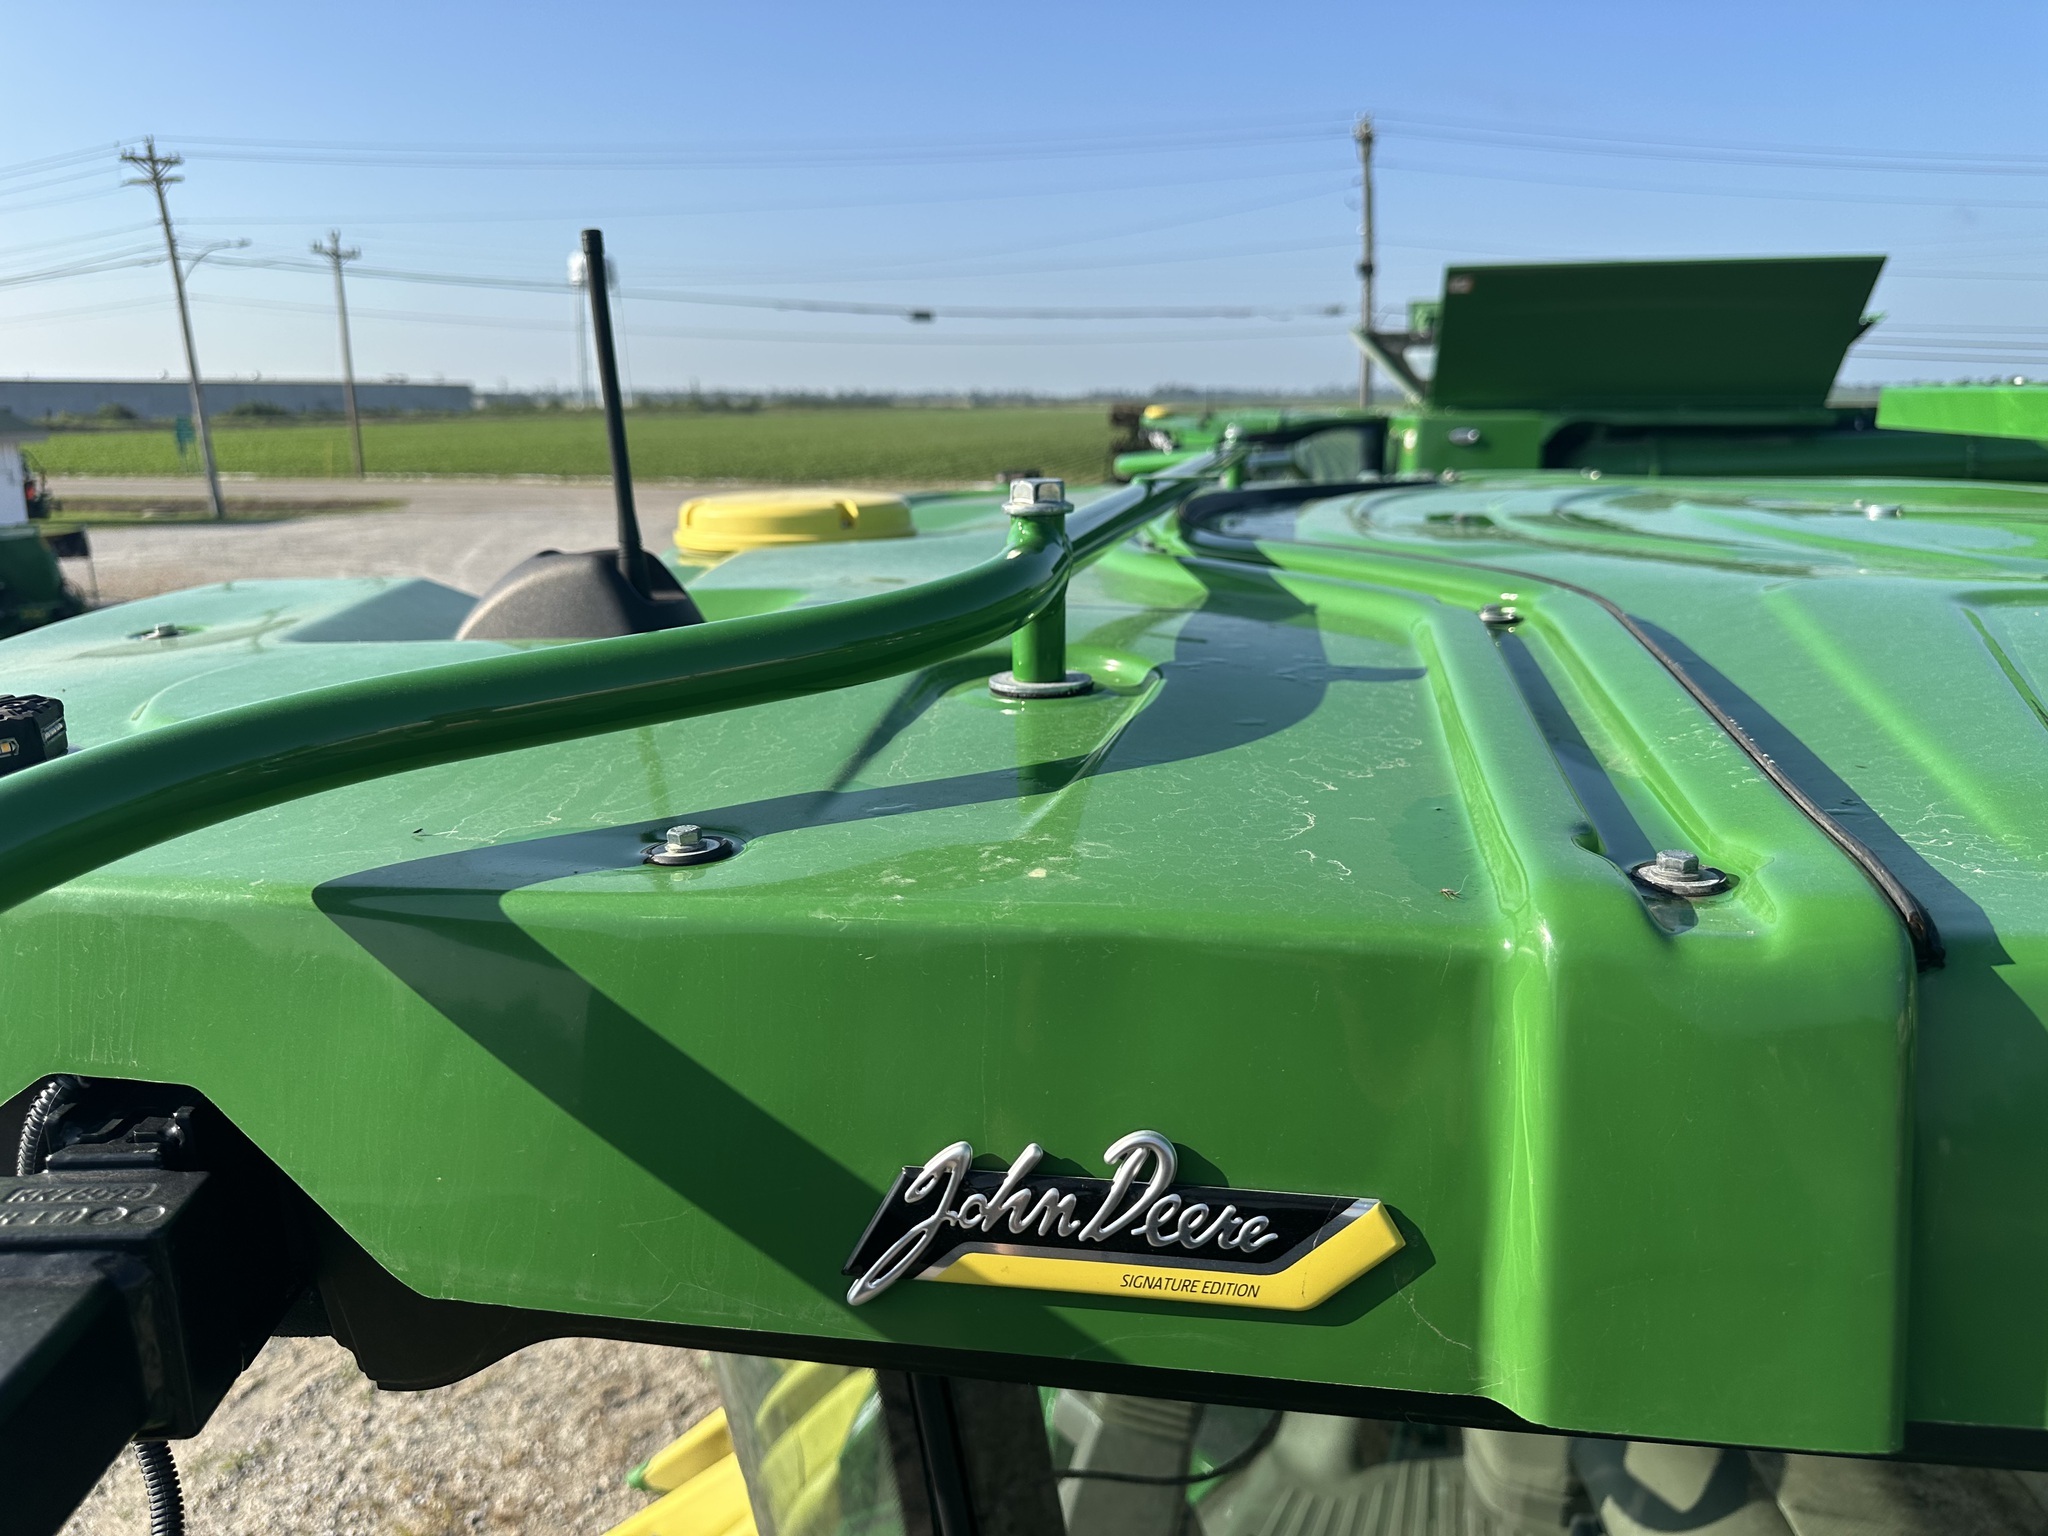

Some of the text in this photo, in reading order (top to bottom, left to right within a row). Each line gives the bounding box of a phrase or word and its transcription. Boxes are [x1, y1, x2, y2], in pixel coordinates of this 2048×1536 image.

[847, 1130, 1278, 1306] John Deere
[1120, 1274, 1260, 1298] SIGNATURE EDITION
